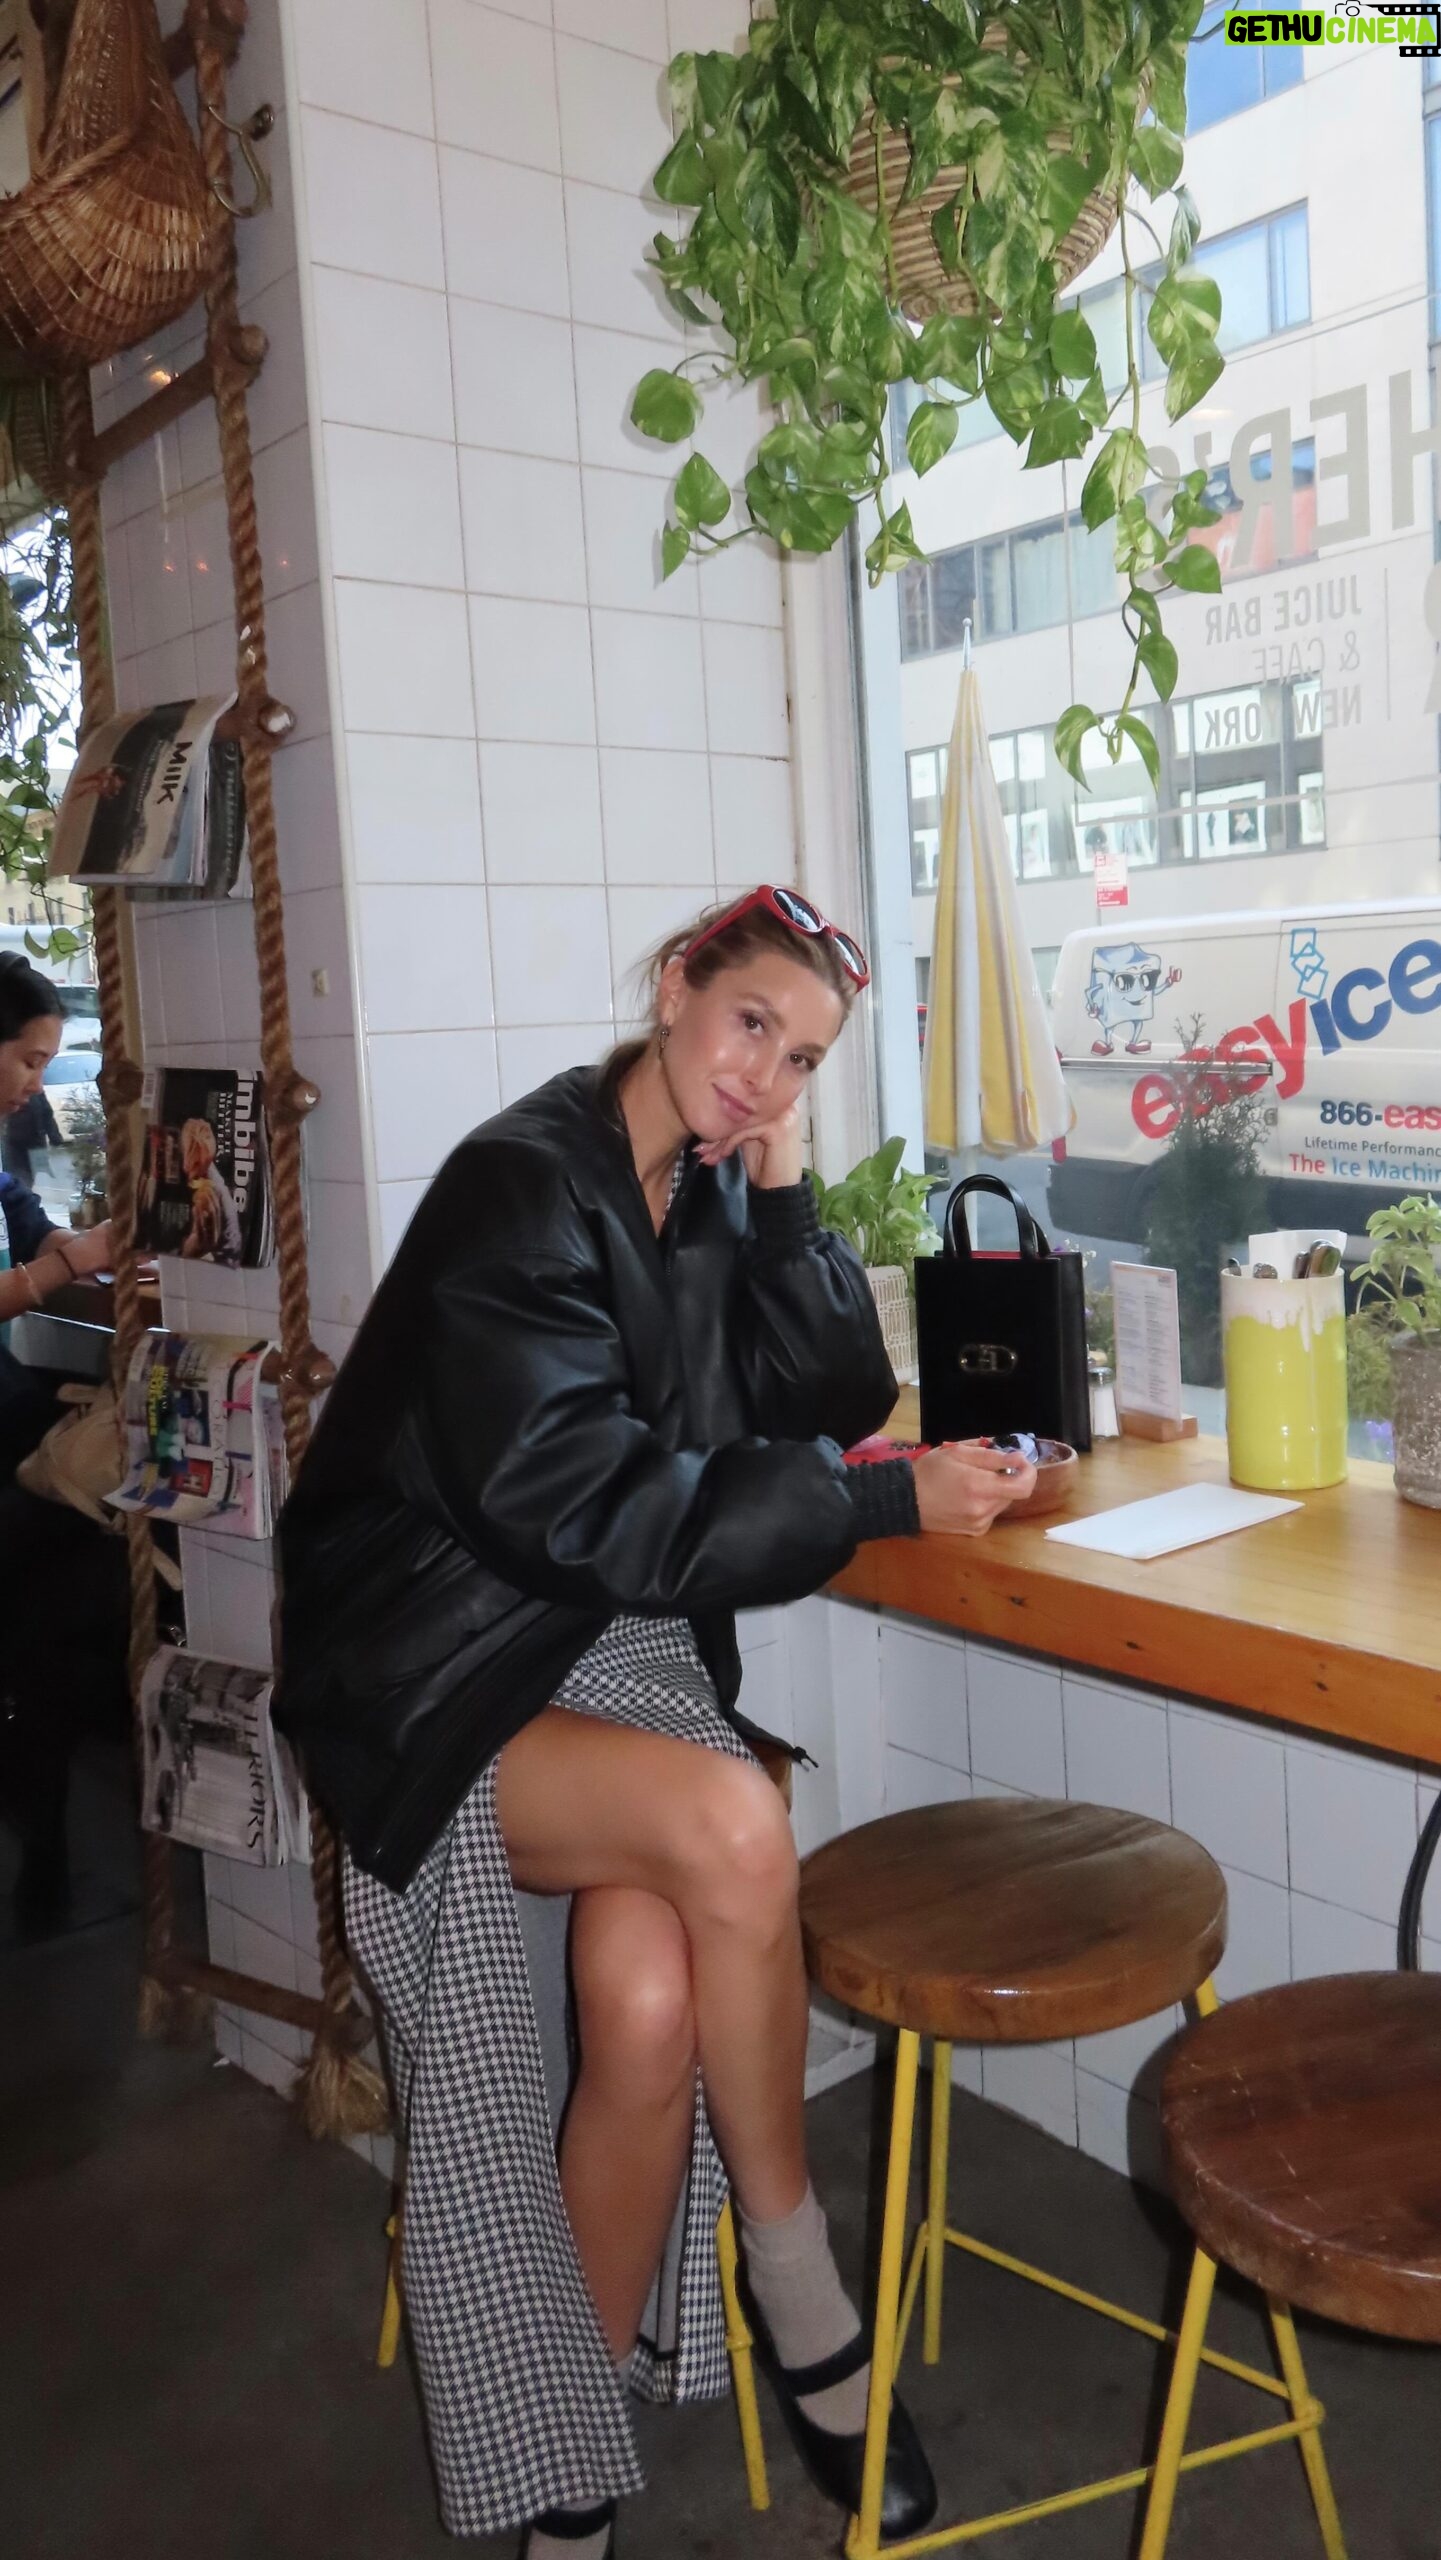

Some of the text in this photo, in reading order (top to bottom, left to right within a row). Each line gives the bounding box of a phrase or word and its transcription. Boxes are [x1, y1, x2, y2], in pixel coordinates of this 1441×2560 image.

[234, 1069, 258, 1213] imbibe
[1304, 1136, 1358, 1152] Lifetime
[1289, 1154, 1325, 1174] The
[1332, 1157, 1361, 1177] Ice
